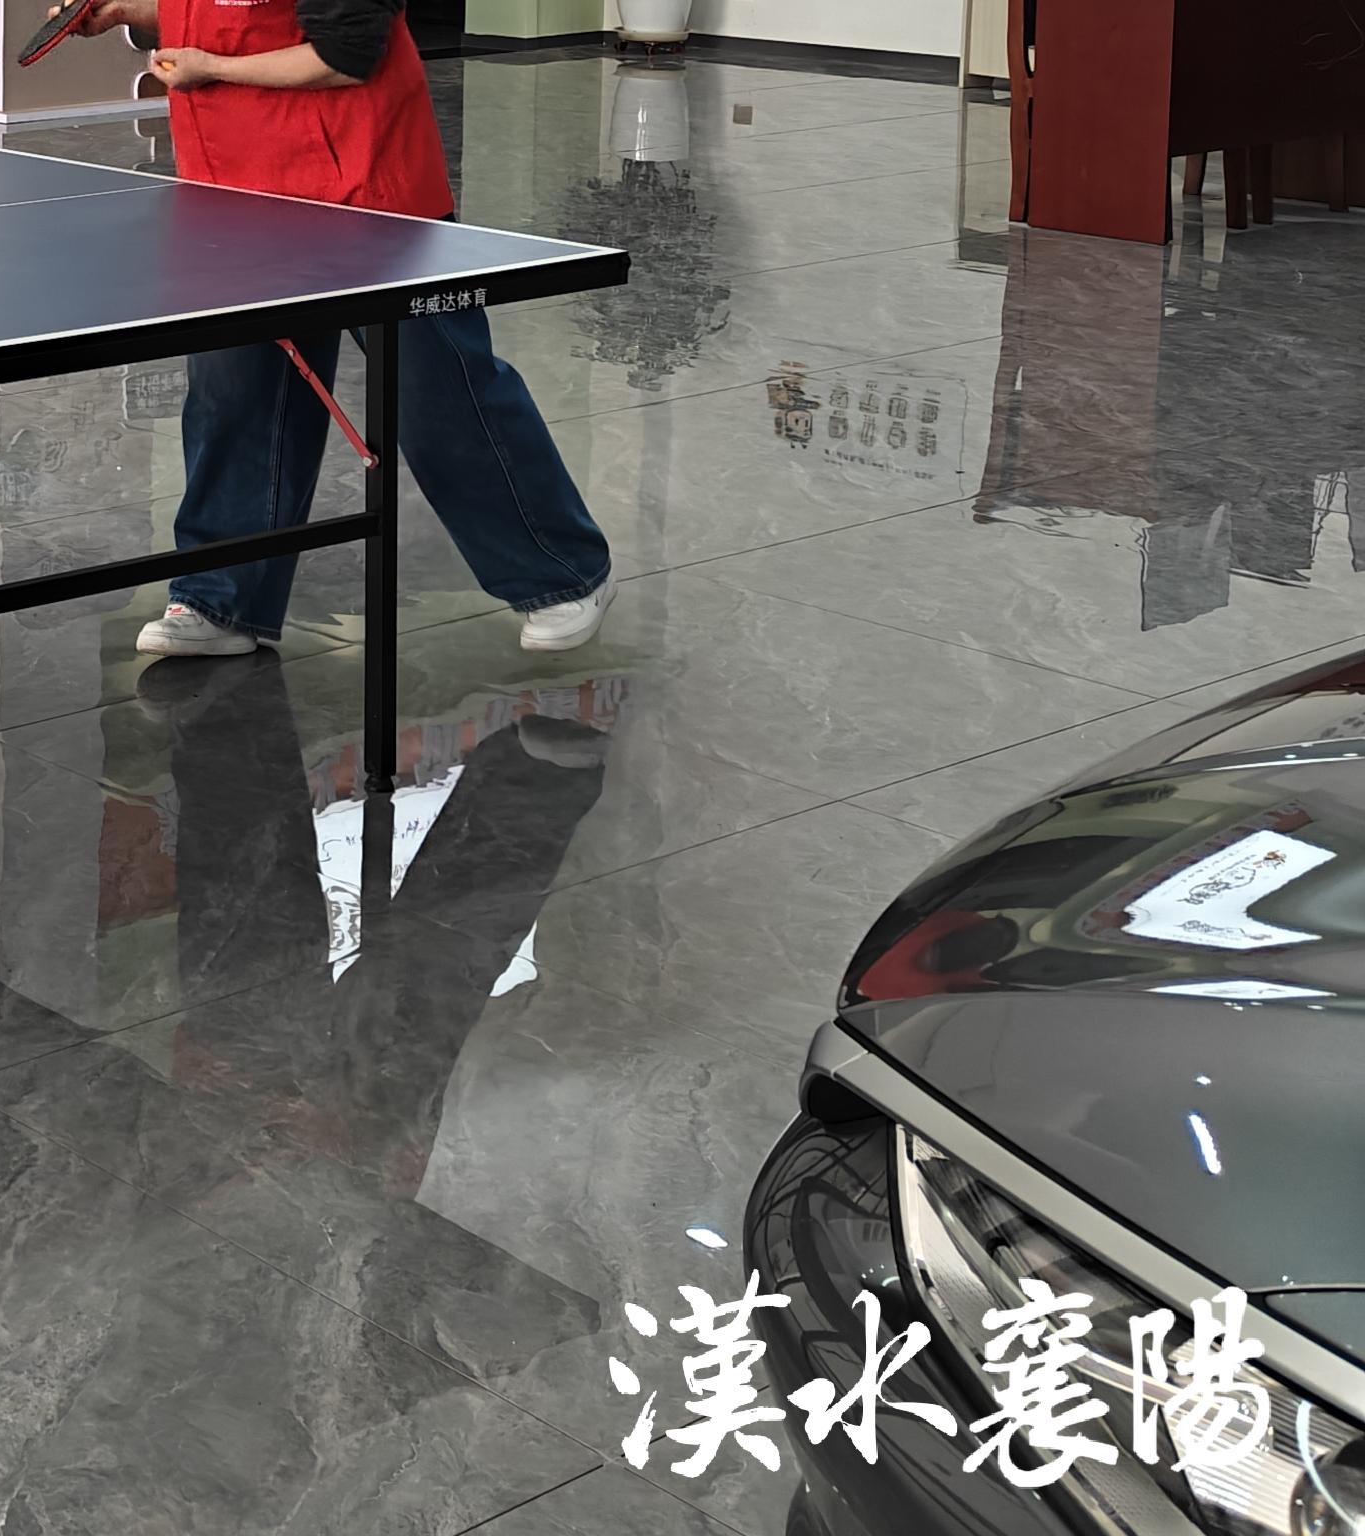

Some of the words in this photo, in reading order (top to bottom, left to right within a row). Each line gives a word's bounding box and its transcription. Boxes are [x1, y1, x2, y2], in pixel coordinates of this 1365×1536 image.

[409, 287, 488, 318] 华威达体育
